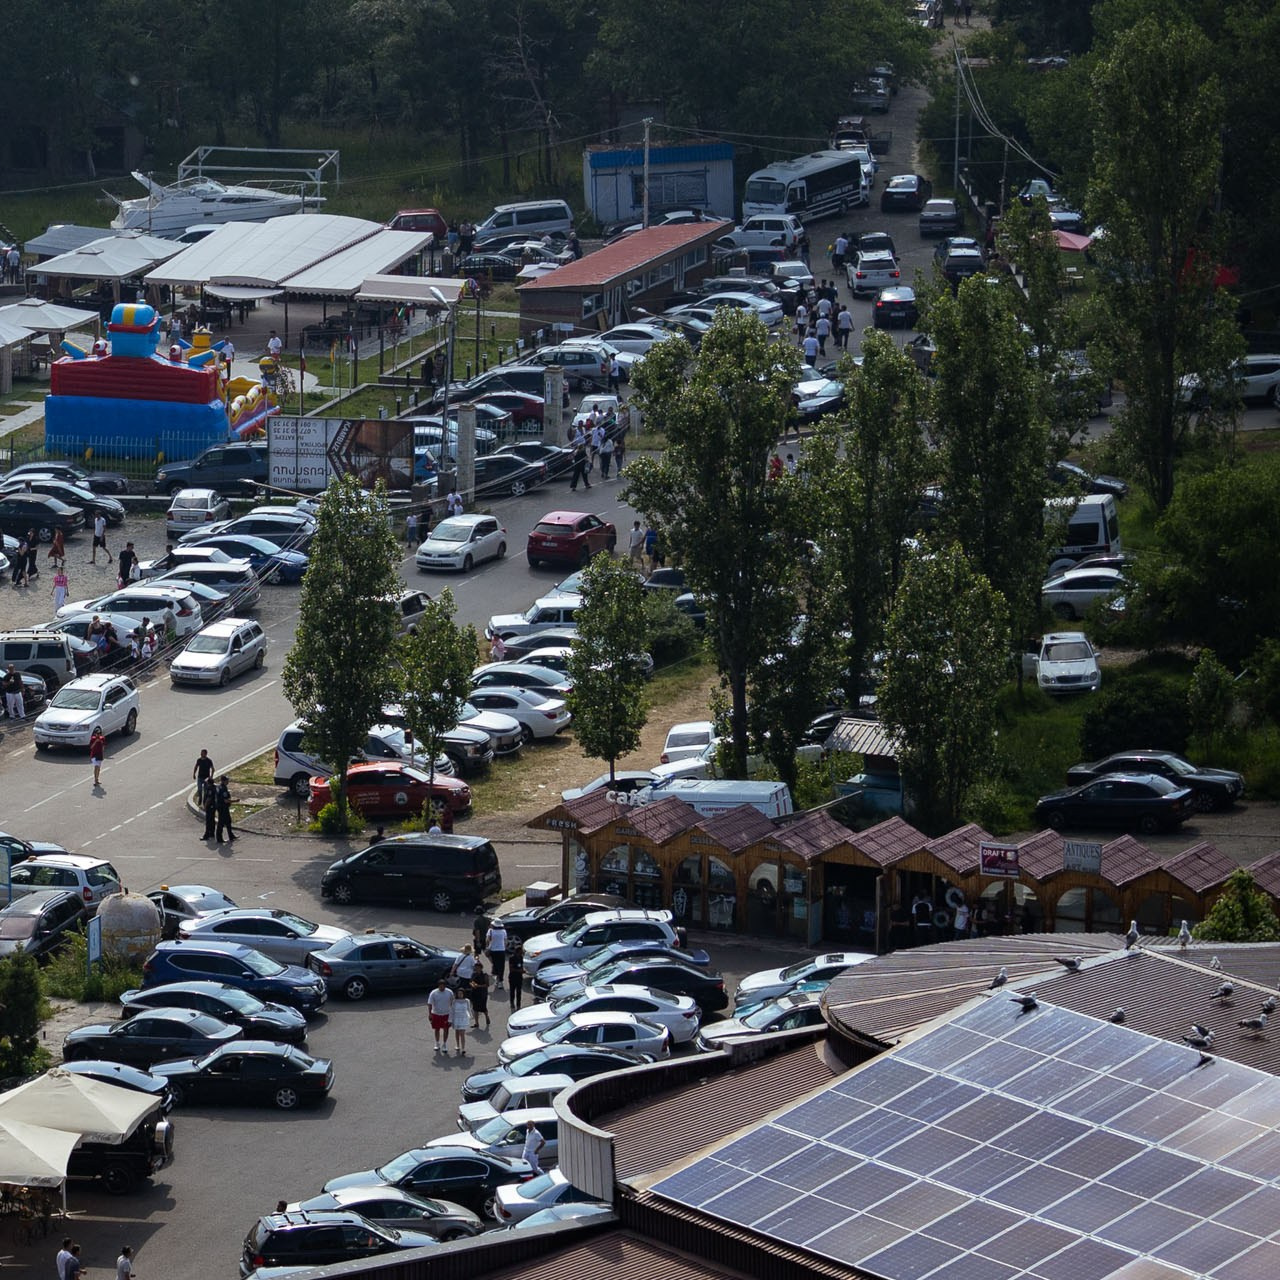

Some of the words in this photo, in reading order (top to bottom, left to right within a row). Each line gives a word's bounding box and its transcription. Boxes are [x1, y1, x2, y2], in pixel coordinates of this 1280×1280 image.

[333, 420, 352, 453] KAMBUZ
[605, 789, 649, 807] cafe
[983, 849, 1005, 857] DRAFT
[1065, 842, 1100, 858] ANTIQUES
